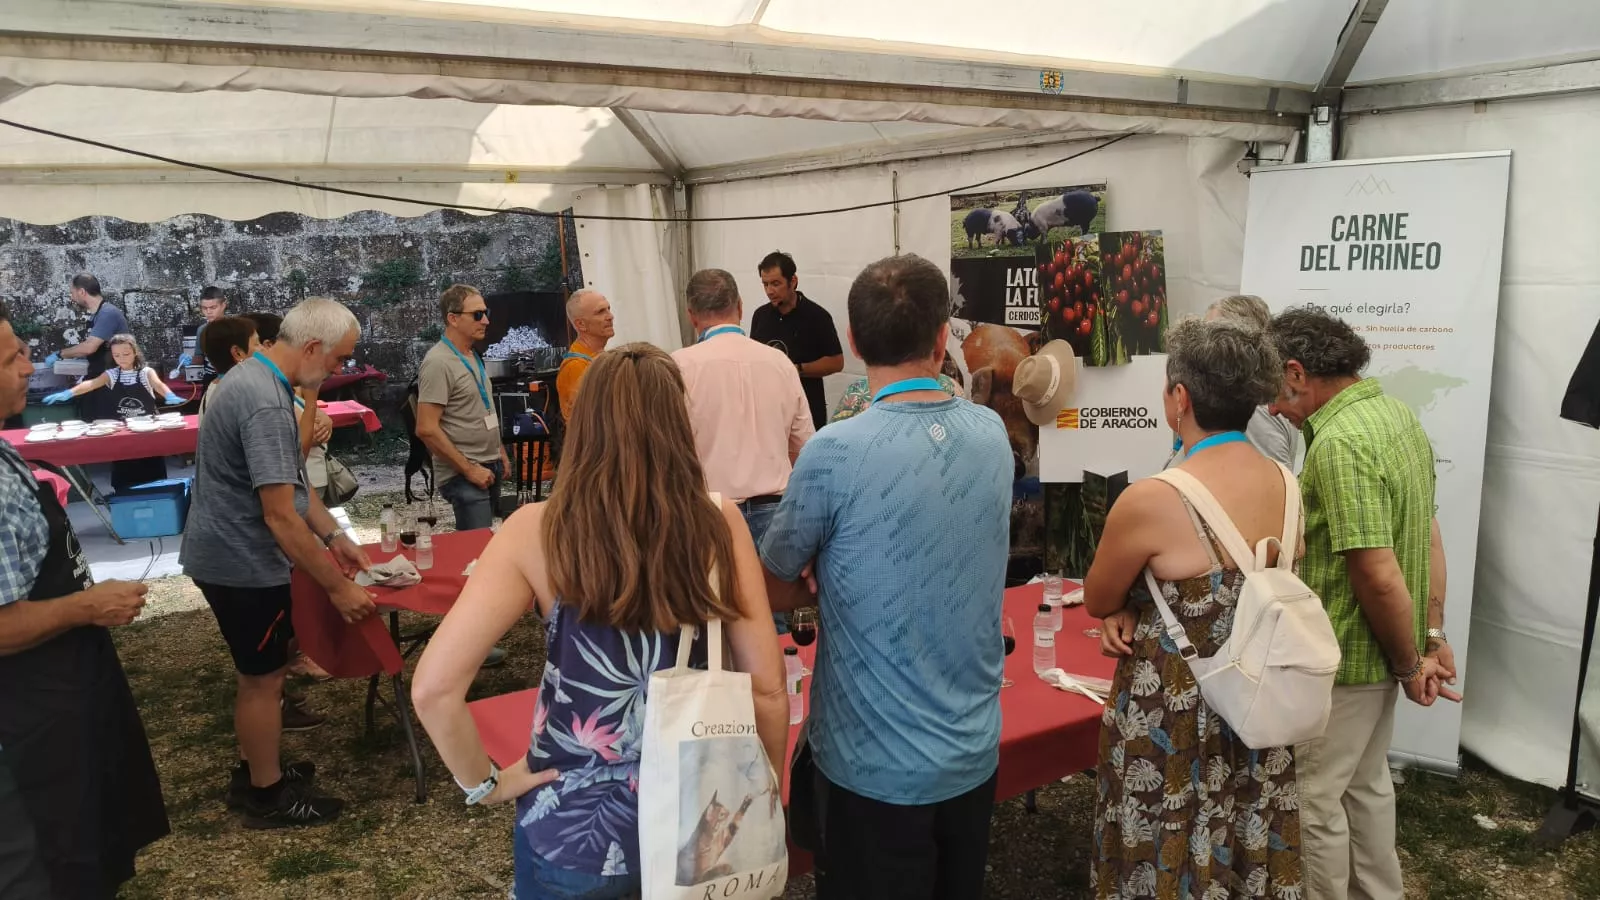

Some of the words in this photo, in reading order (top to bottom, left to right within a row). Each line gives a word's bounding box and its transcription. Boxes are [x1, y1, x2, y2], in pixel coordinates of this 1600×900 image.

[1331, 213, 1409, 241] CARNE
[1300, 245, 1340, 271] DEL
[1347, 242, 1441, 270] PIRINEO
[1005, 287, 1023, 306] LA
[1008, 310, 1040, 321] CERDOS
[1330, 303, 1352, 315] qué
[1356, 302, 1411, 316] elegirla?
[1366, 324, 1378, 332] Sin
[1080, 407, 1148, 418] GOBIERNO
[1080, 418, 1097, 429] DE
[1101, 418, 1158, 429] ARAGON
[703, 866, 780, 900] ROMA
